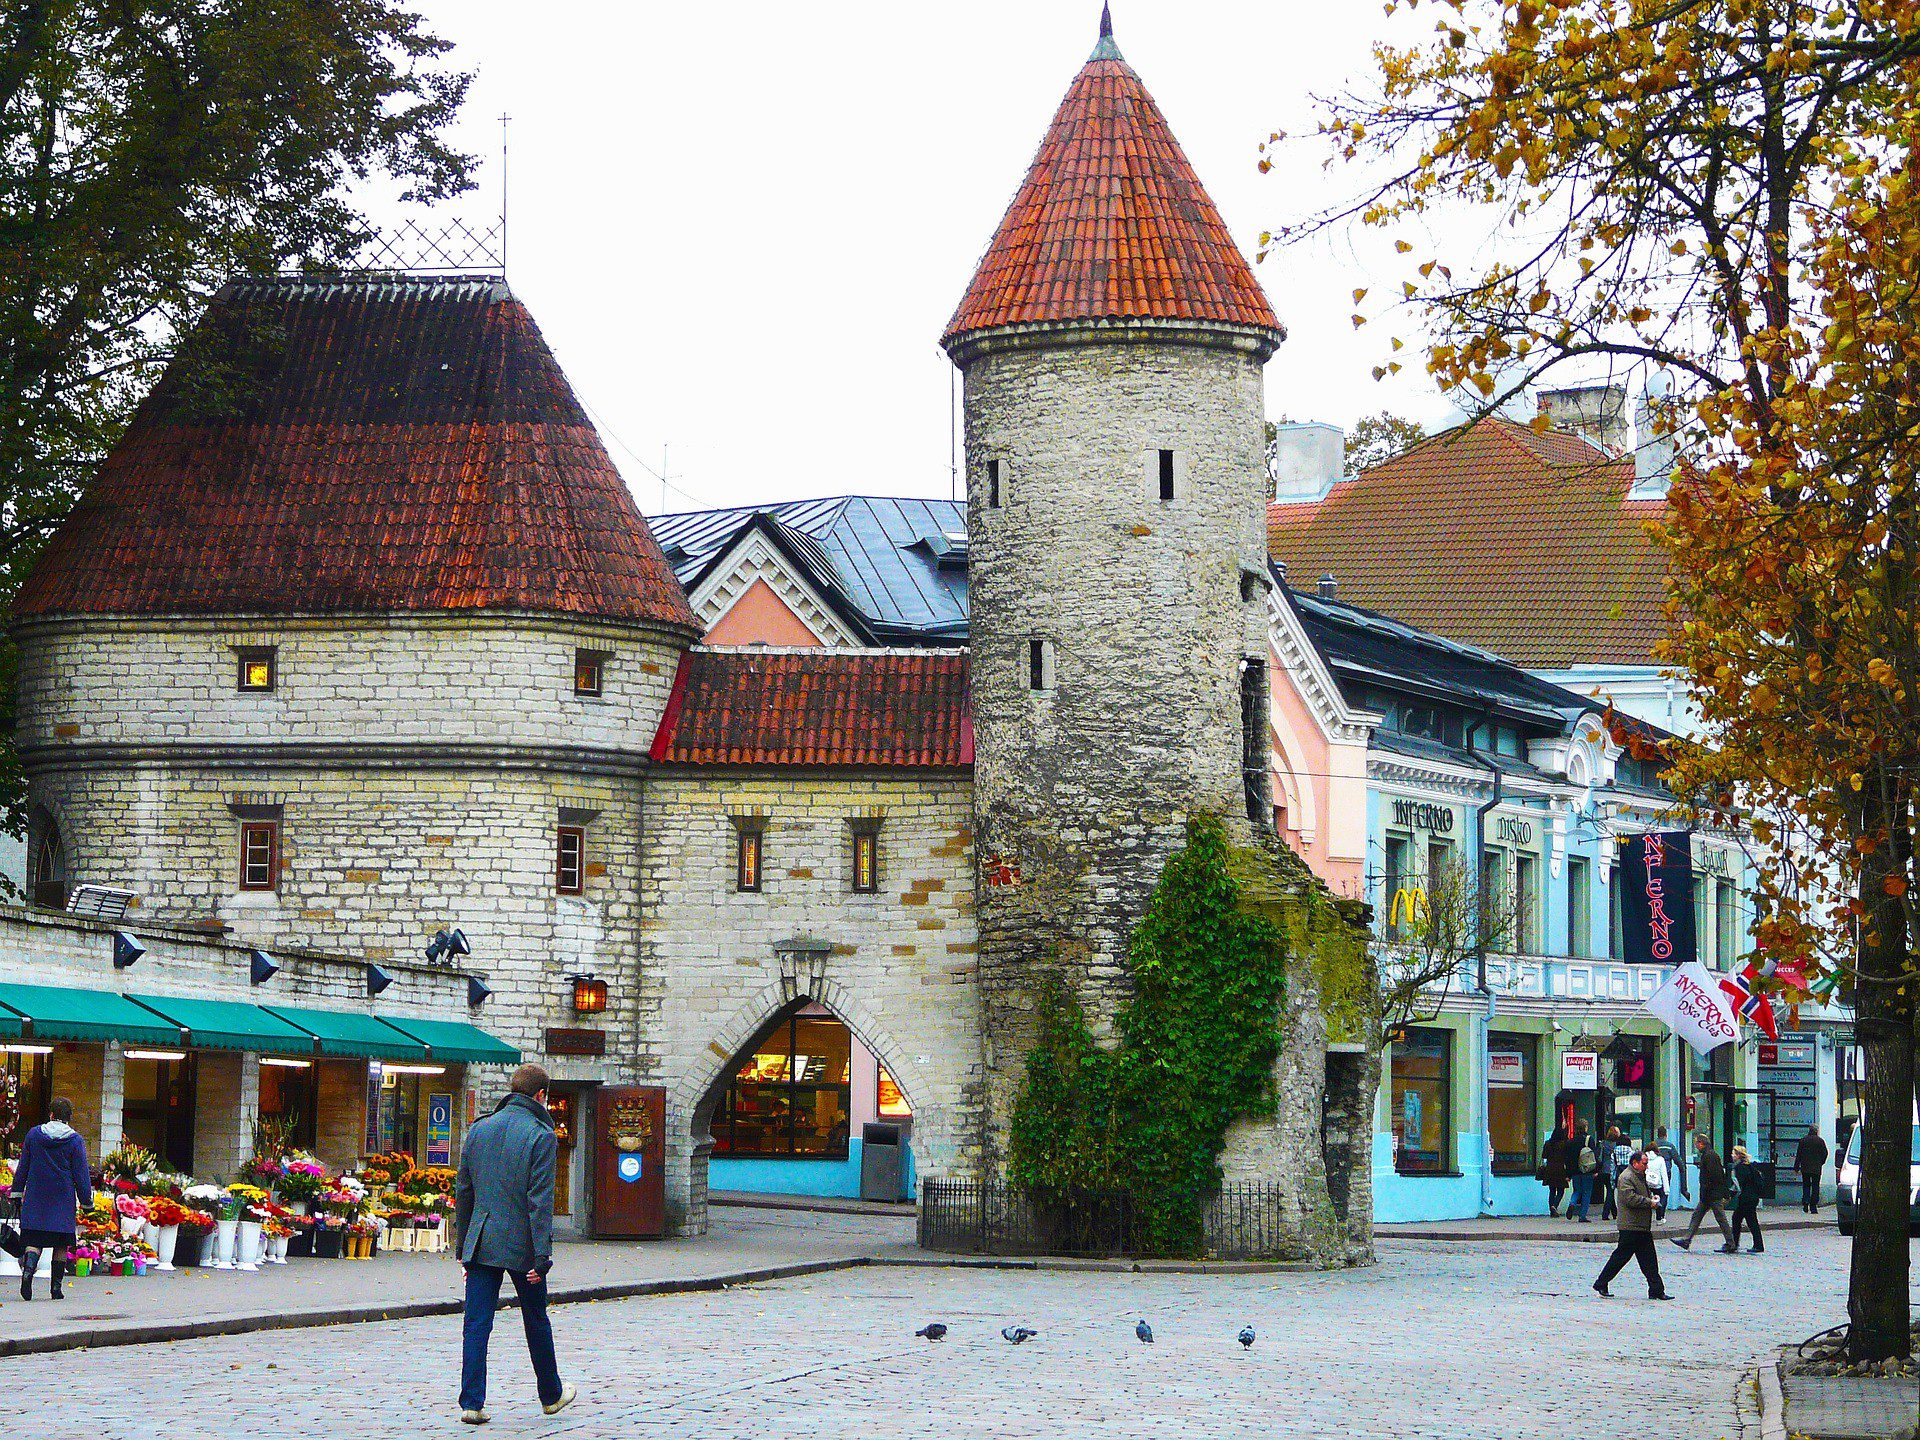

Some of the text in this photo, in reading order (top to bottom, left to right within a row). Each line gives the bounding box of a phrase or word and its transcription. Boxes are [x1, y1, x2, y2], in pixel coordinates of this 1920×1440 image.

[1391, 799, 1454, 843] INFERNO
[1673, 973, 1736, 1038] INFERNO
[1697, 1020, 1720, 1038] Club
